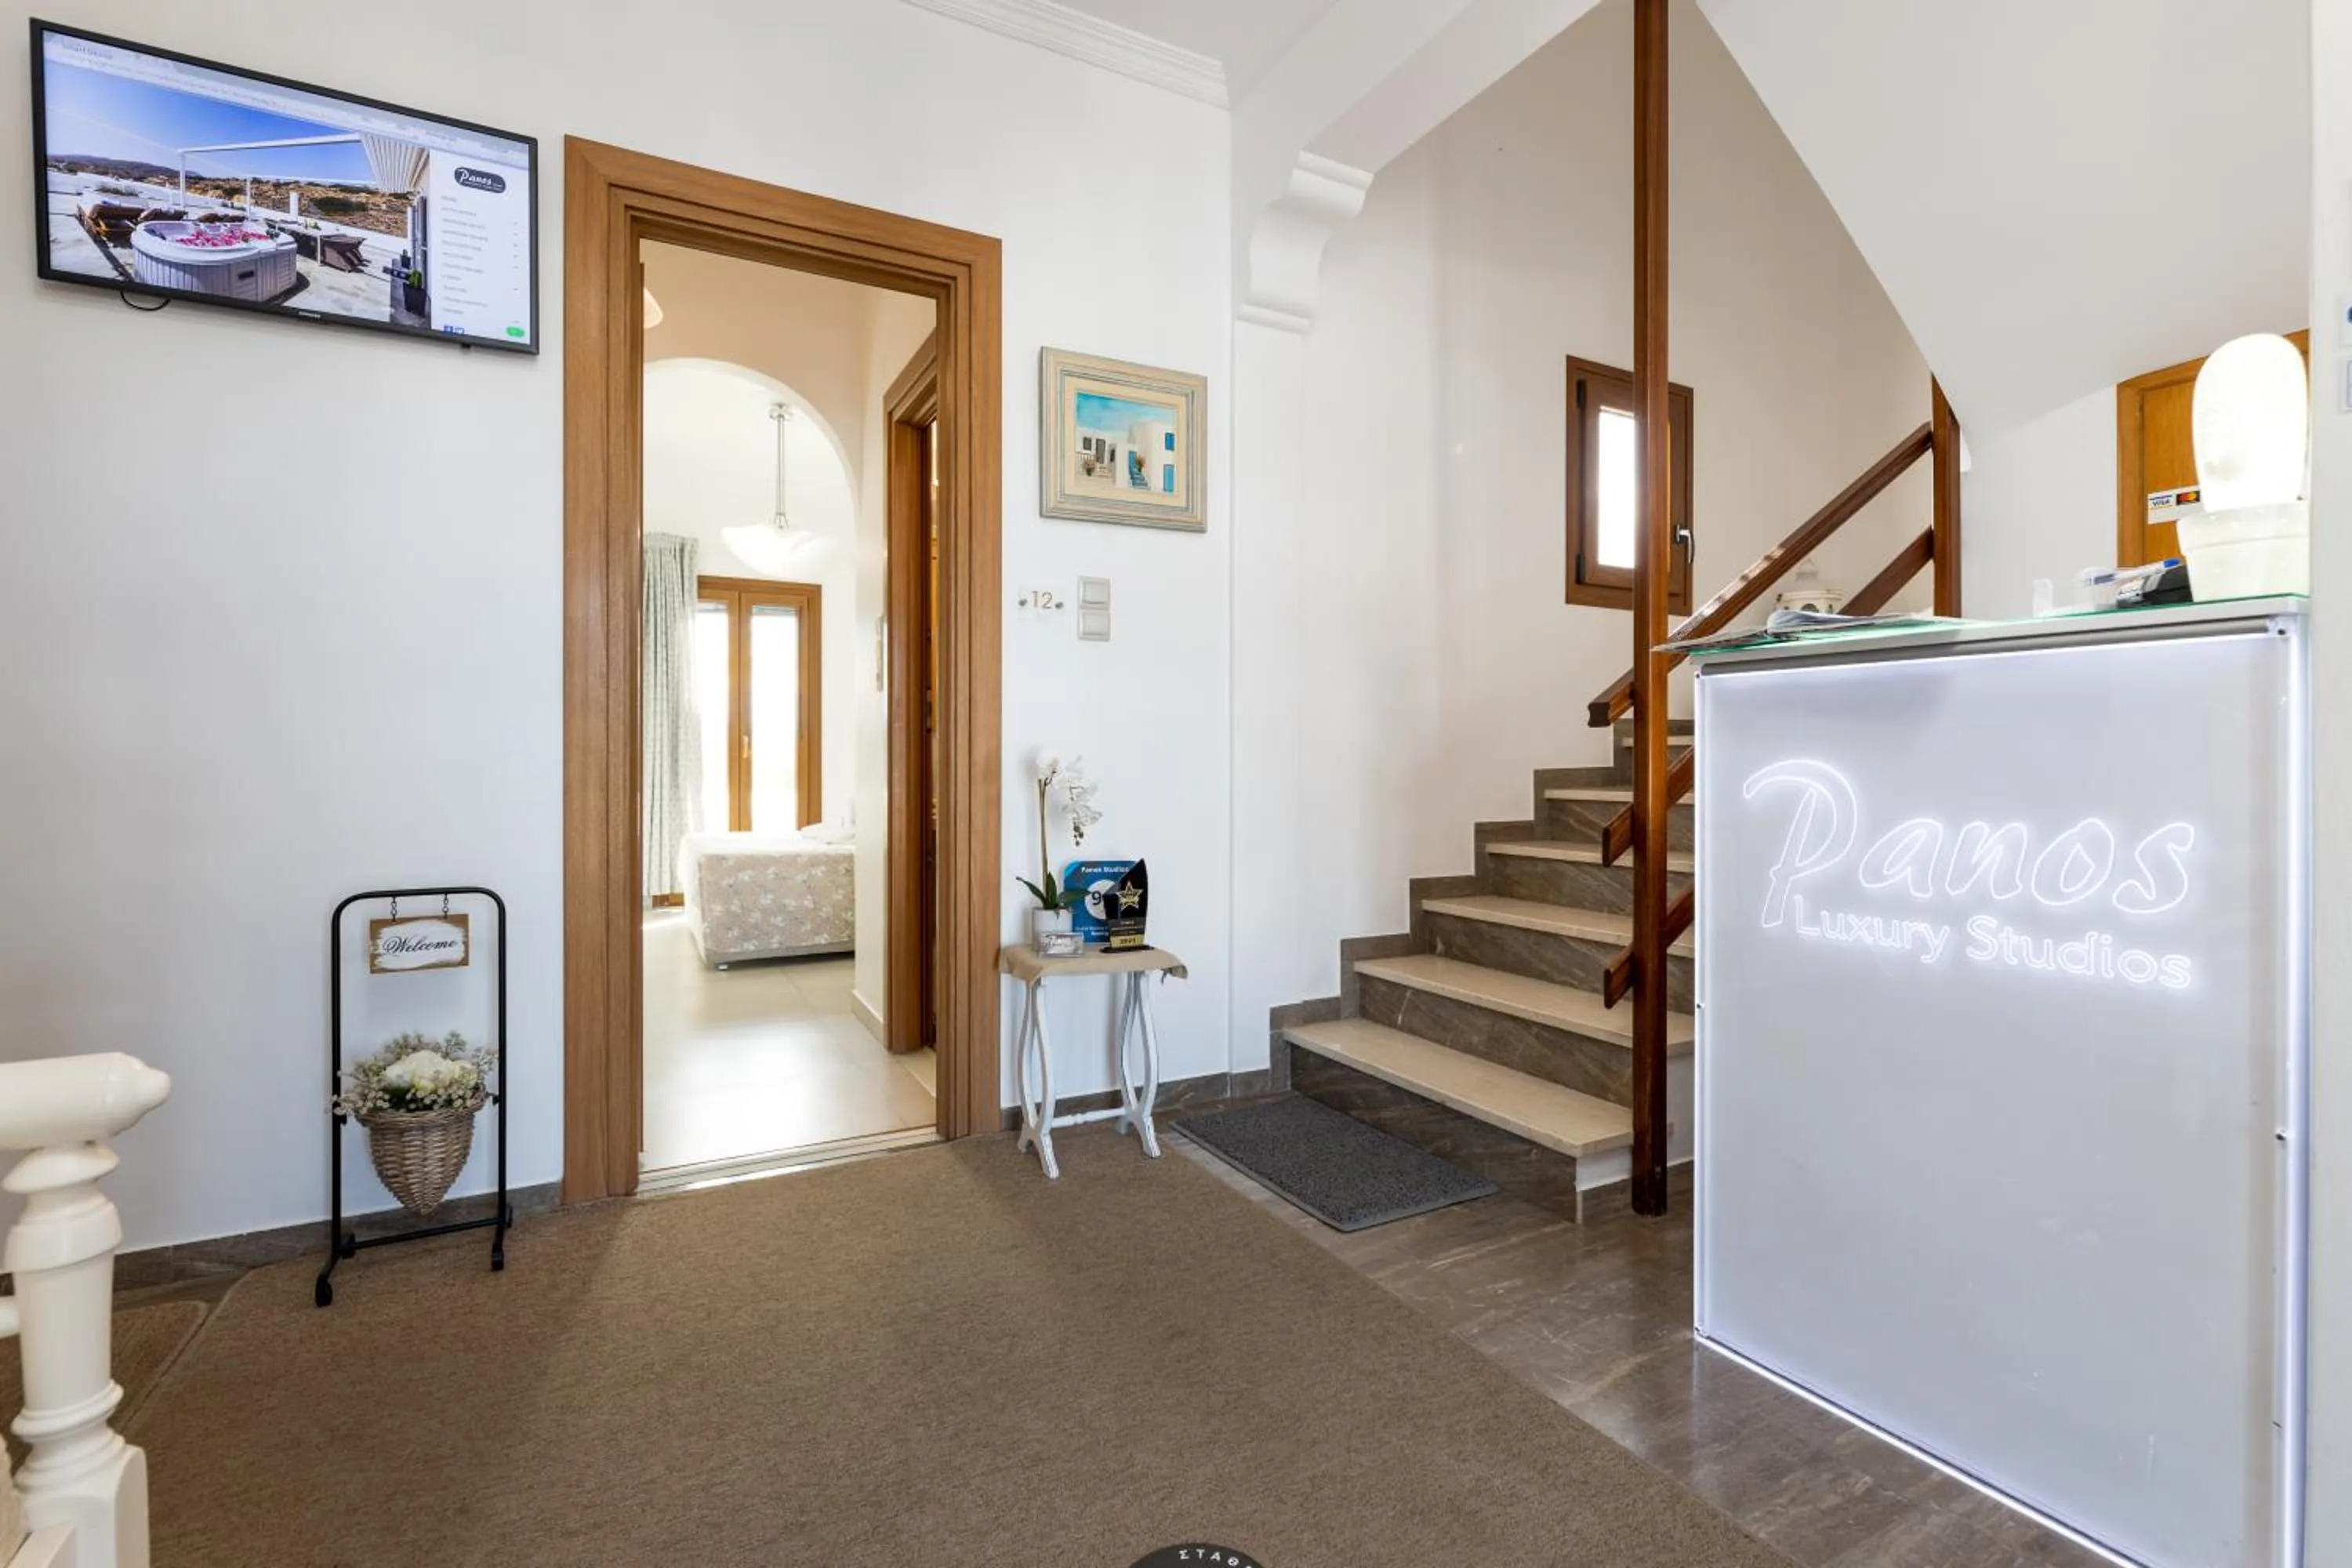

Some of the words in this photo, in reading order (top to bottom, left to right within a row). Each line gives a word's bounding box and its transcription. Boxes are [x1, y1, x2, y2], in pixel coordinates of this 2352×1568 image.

[1031, 590, 1053, 610] 12
[1742, 758, 2195, 927] Panos
[382, 934, 457, 956] Welcome
[1793, 894, 1950, 964] Luxury
[1965, 915, 2192, 989] Studios
[1178, 1548, 1253, 1568] ΣΤΑΘ
